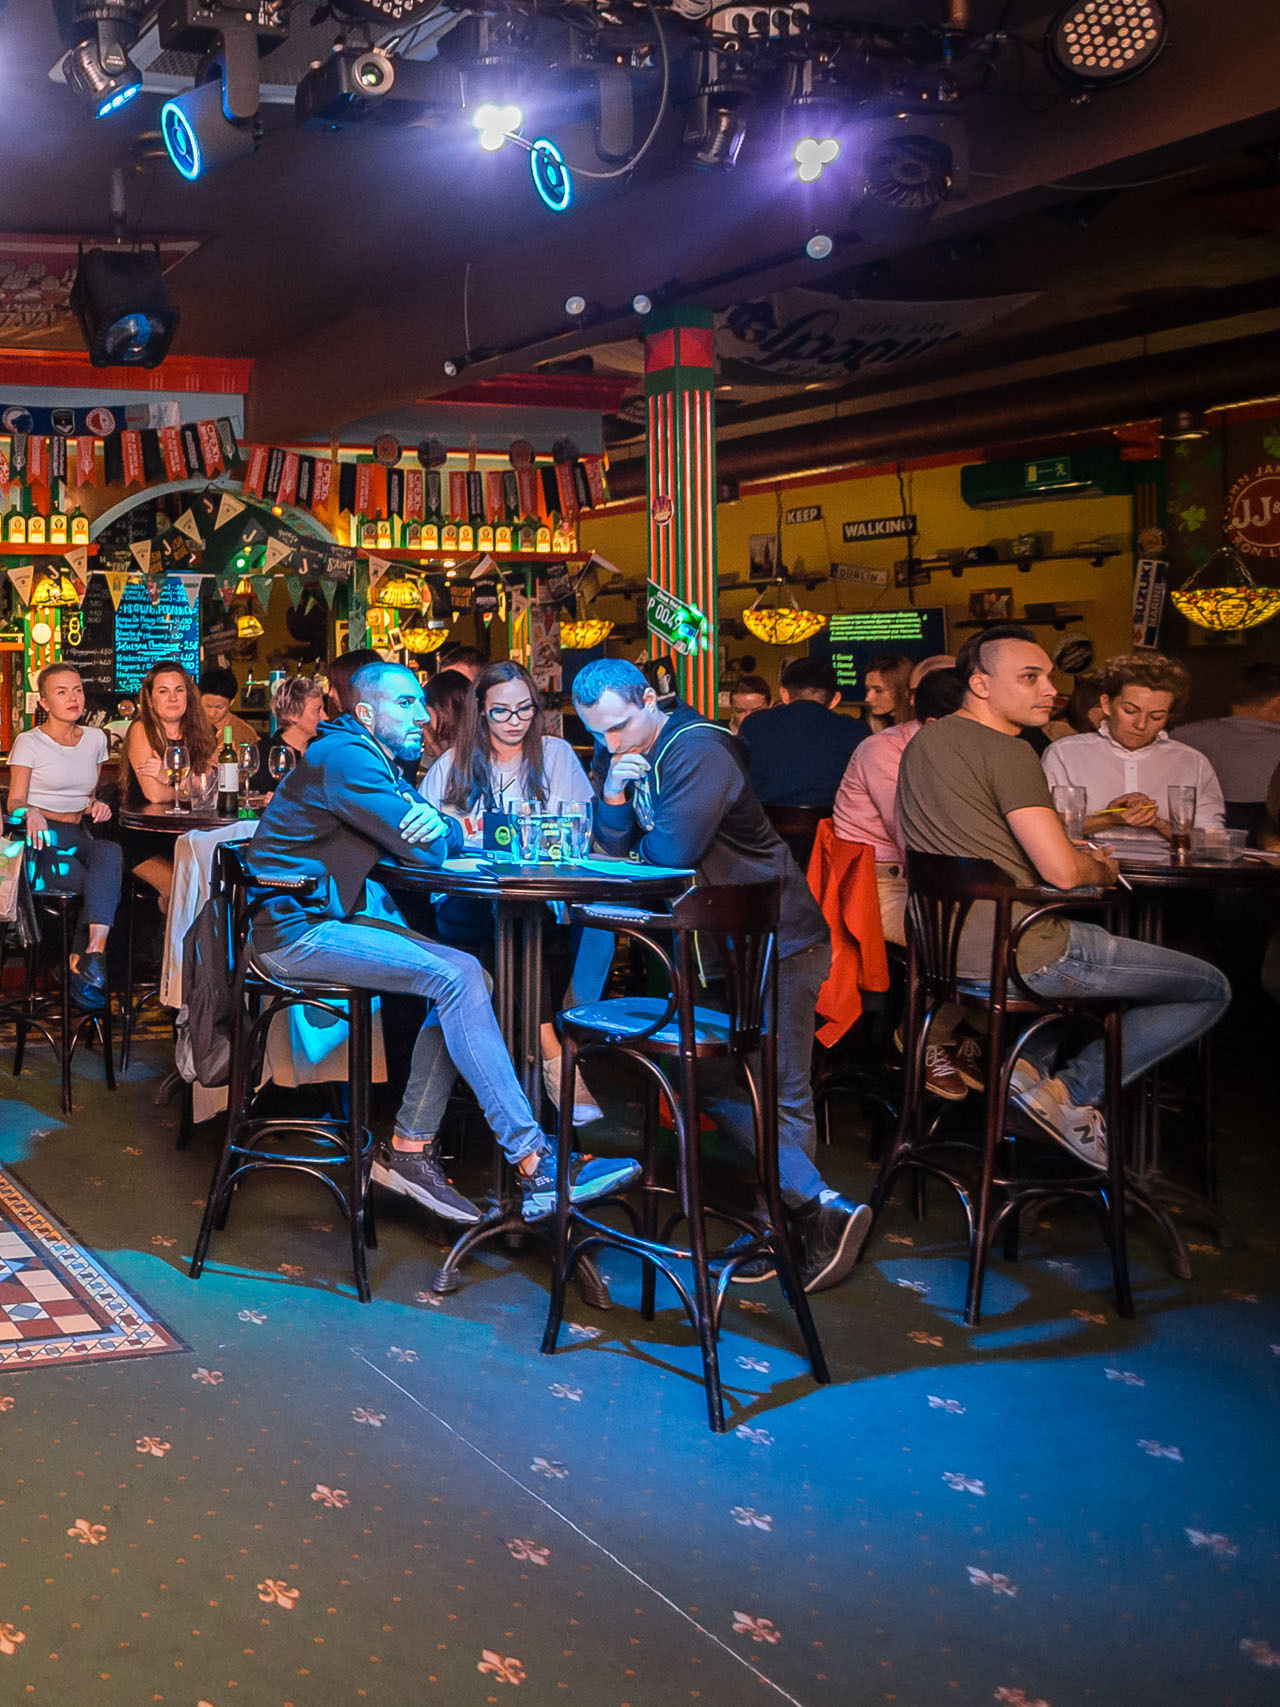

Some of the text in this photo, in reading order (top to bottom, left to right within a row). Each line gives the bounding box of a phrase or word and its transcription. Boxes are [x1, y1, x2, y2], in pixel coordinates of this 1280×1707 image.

[786, 508, 819, 523] KEEP
[844, 518, 913, 538] WALKING
[839, 567, 878, 582] DUBLIN
[1133, 561, 1153, 625] SUZUKI
